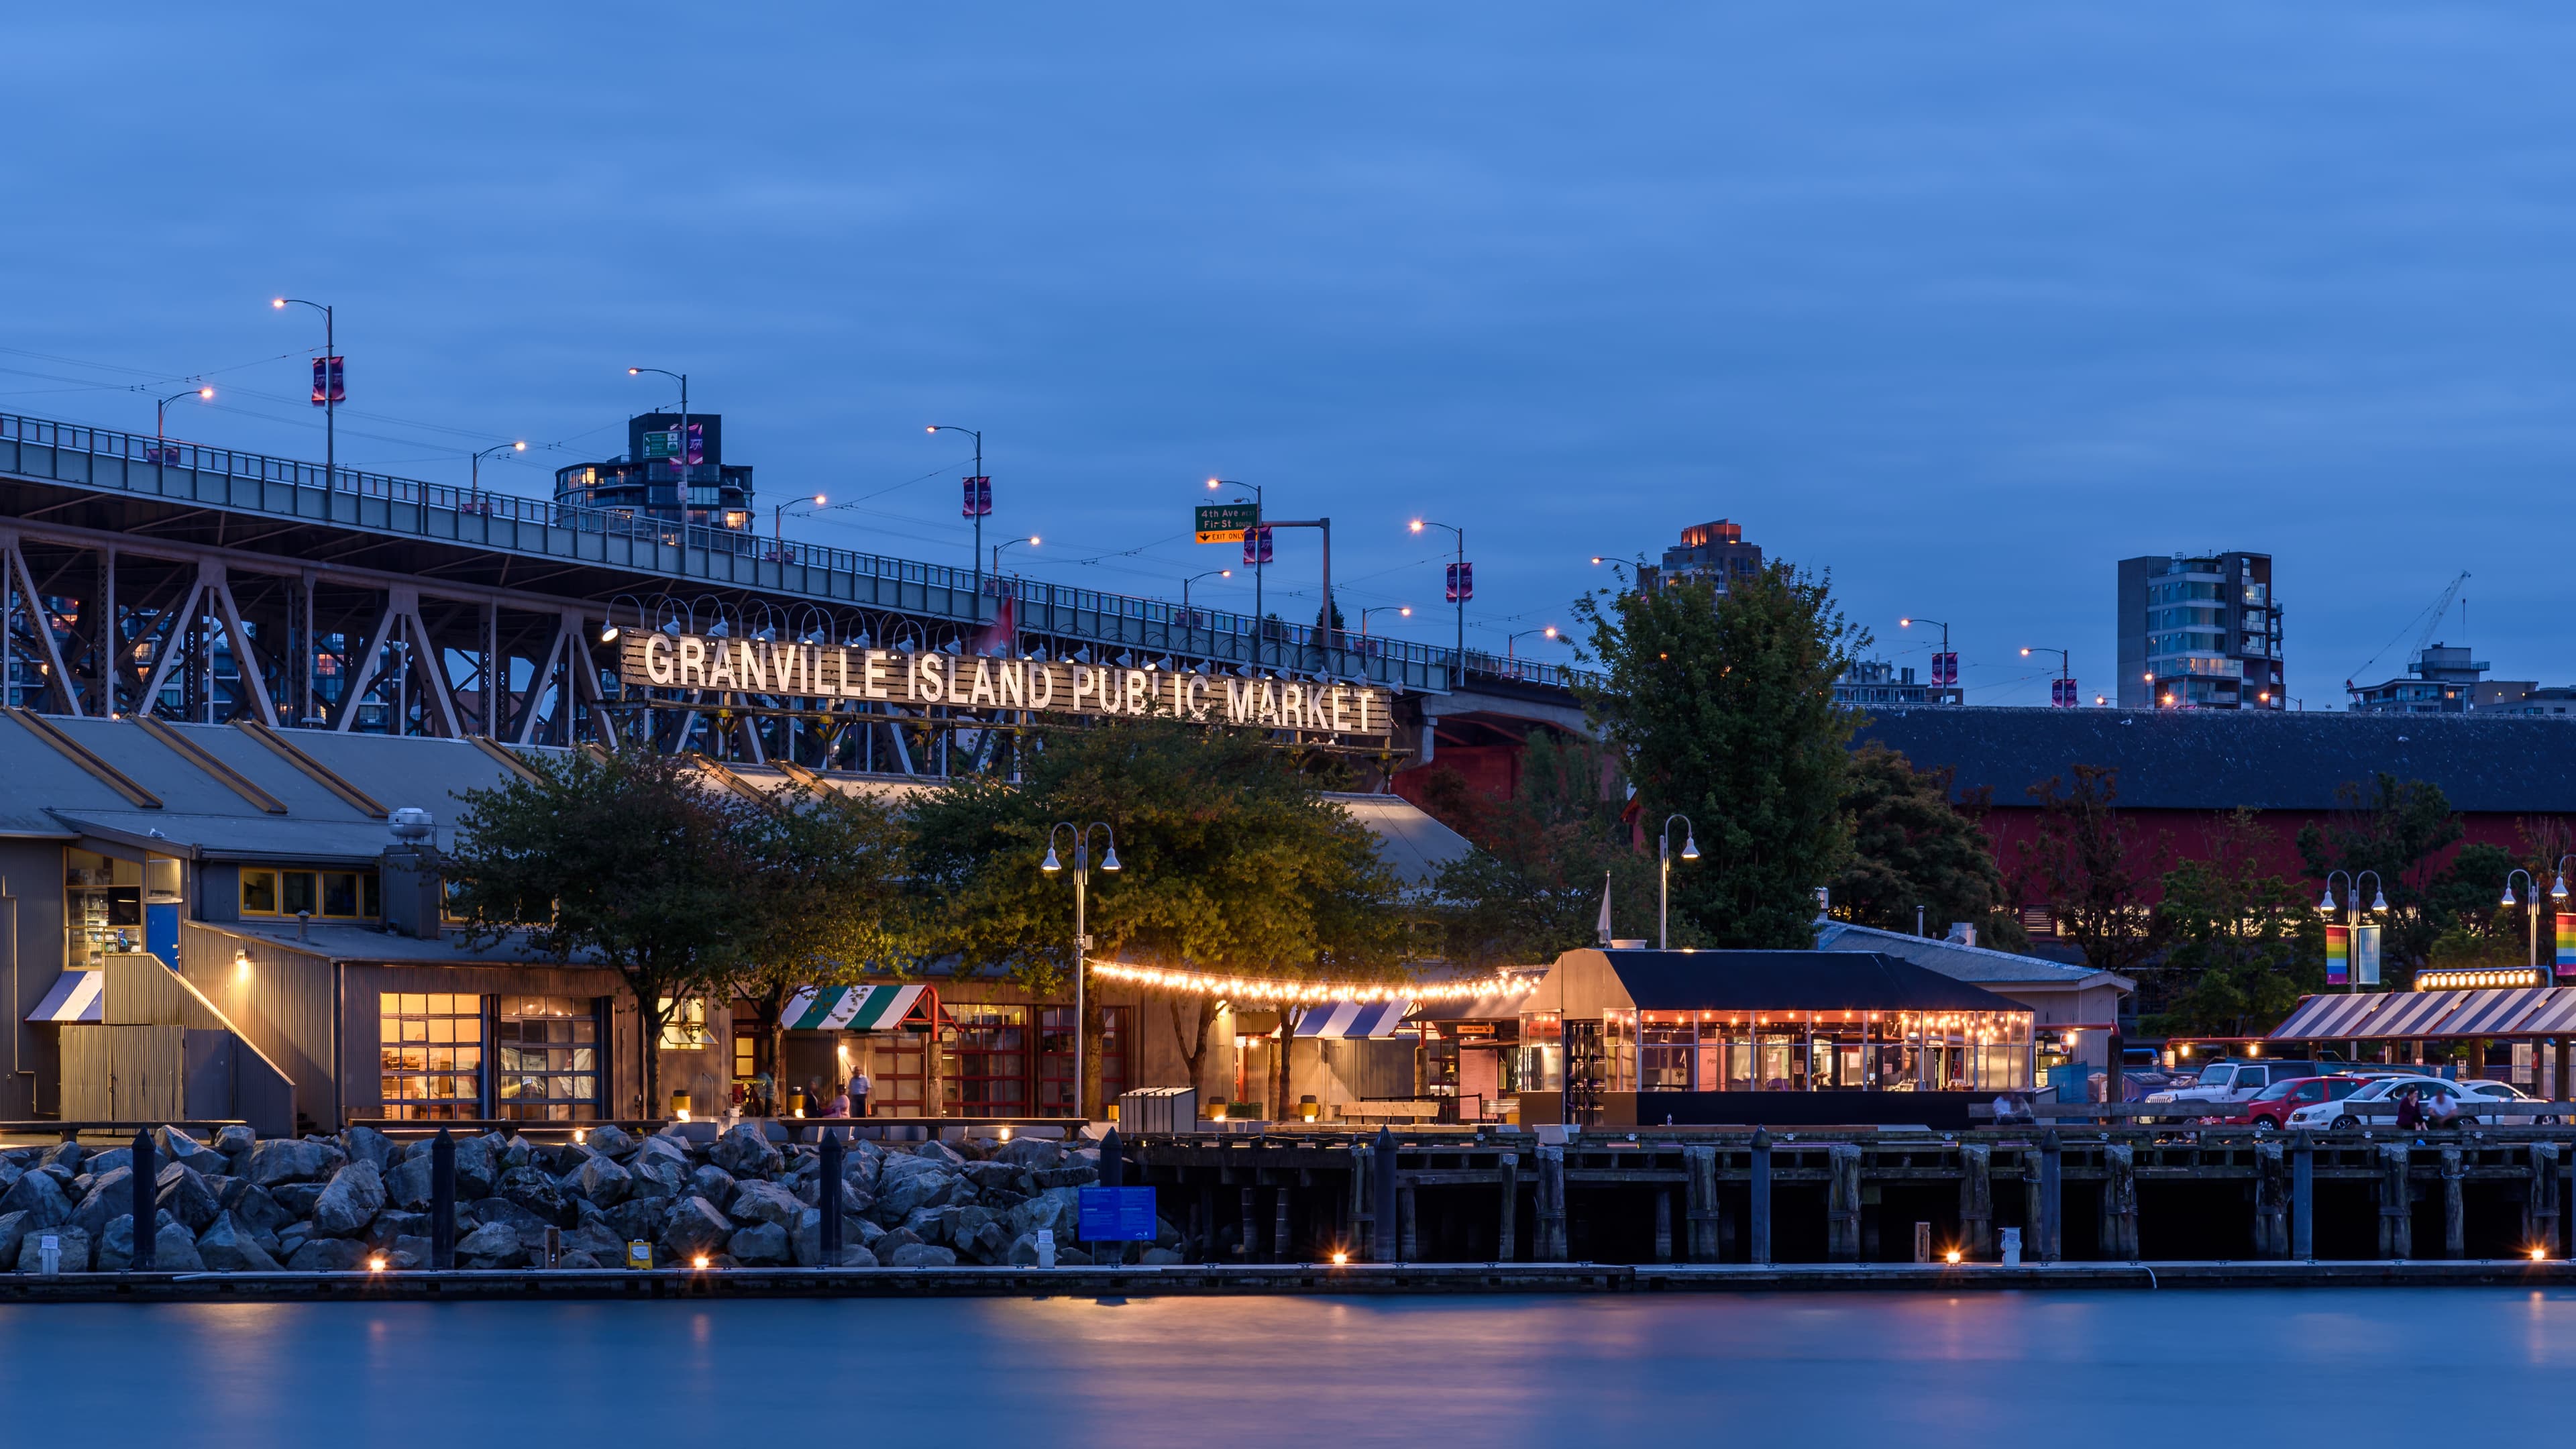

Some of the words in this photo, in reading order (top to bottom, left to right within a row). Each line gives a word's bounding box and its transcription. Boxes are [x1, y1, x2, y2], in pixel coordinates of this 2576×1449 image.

[1201, 510, 1218, 518] 4th
[1204, 520, 1219, 529] Fir
[645, 633, 888, 698] GRANVILLE
[908, 653, 1053, 709] ISLAND
[1073, 665, 1210, 722] PUBLIC
[1227, 678, 1374, 733] MARKET
